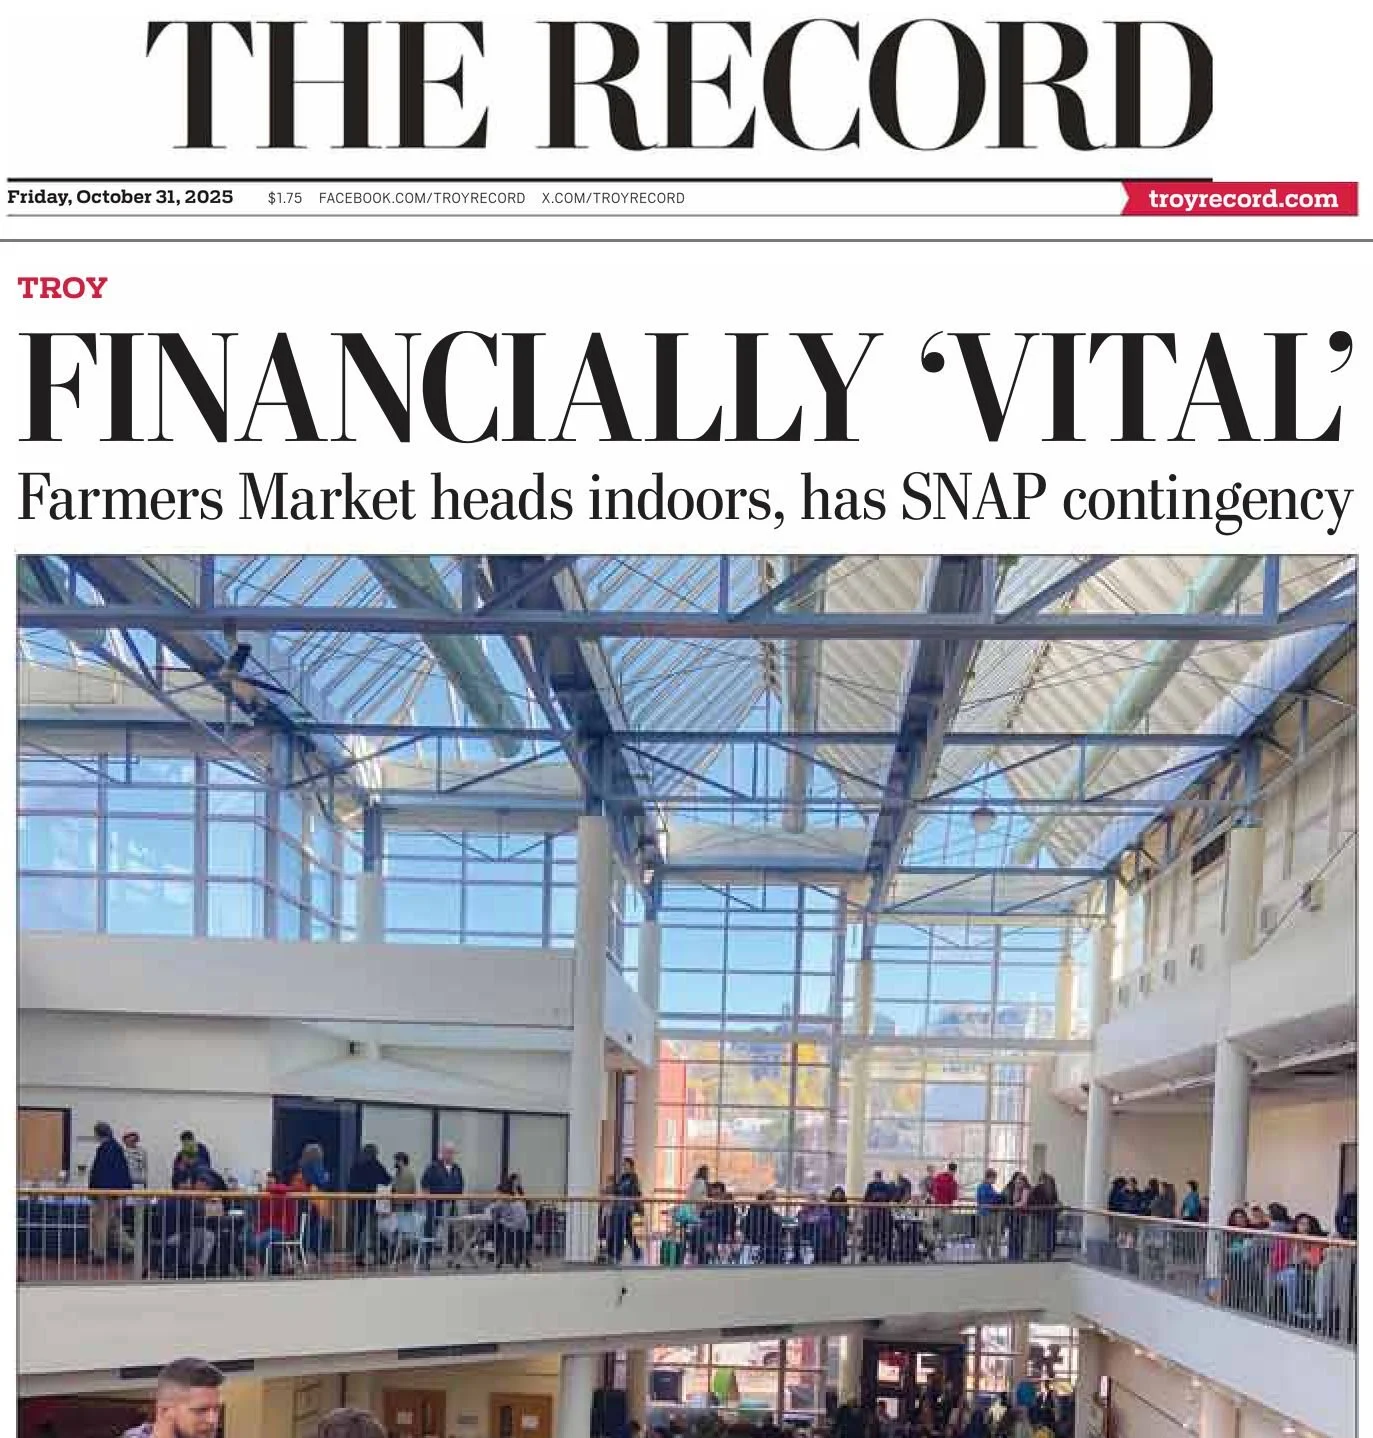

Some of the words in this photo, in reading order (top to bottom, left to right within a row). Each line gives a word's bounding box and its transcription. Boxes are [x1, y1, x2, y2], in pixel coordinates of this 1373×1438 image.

[146, 21, 488, 148] THE
[536, 19, 1213, 151] RECORD
[8, 190, 72, 206] Friday,
[77, 189, 152, 203] October
[156, 190, 180, 205] 31,
[185, 190, 233, 203] 2025
[269, 192, 301, 204] $1.75
[320, 193, 525, 203] FACEBOOK.COM/TROYRECORD
[543, 193, 684, 203] X.COM/TROYRECORD
[1149, 189, 1338, 211] troyrecord.com
[18, 277, 107, 298] TROY
[19, 331, 884, 443] FINANCIALLY
[921, 331, 1352, 441] ‘VITAL’
[18, 473, 223, 520] Farmers
[239, 472, 416, 520] Market
[431, 472, 572, 520] heads
[589, 472, 784, 529] indoors,
[801, 472, 885, 520] has
[903, 472, 1046, 520] SNAP
[1064, 474, 1354, 535] contingency
